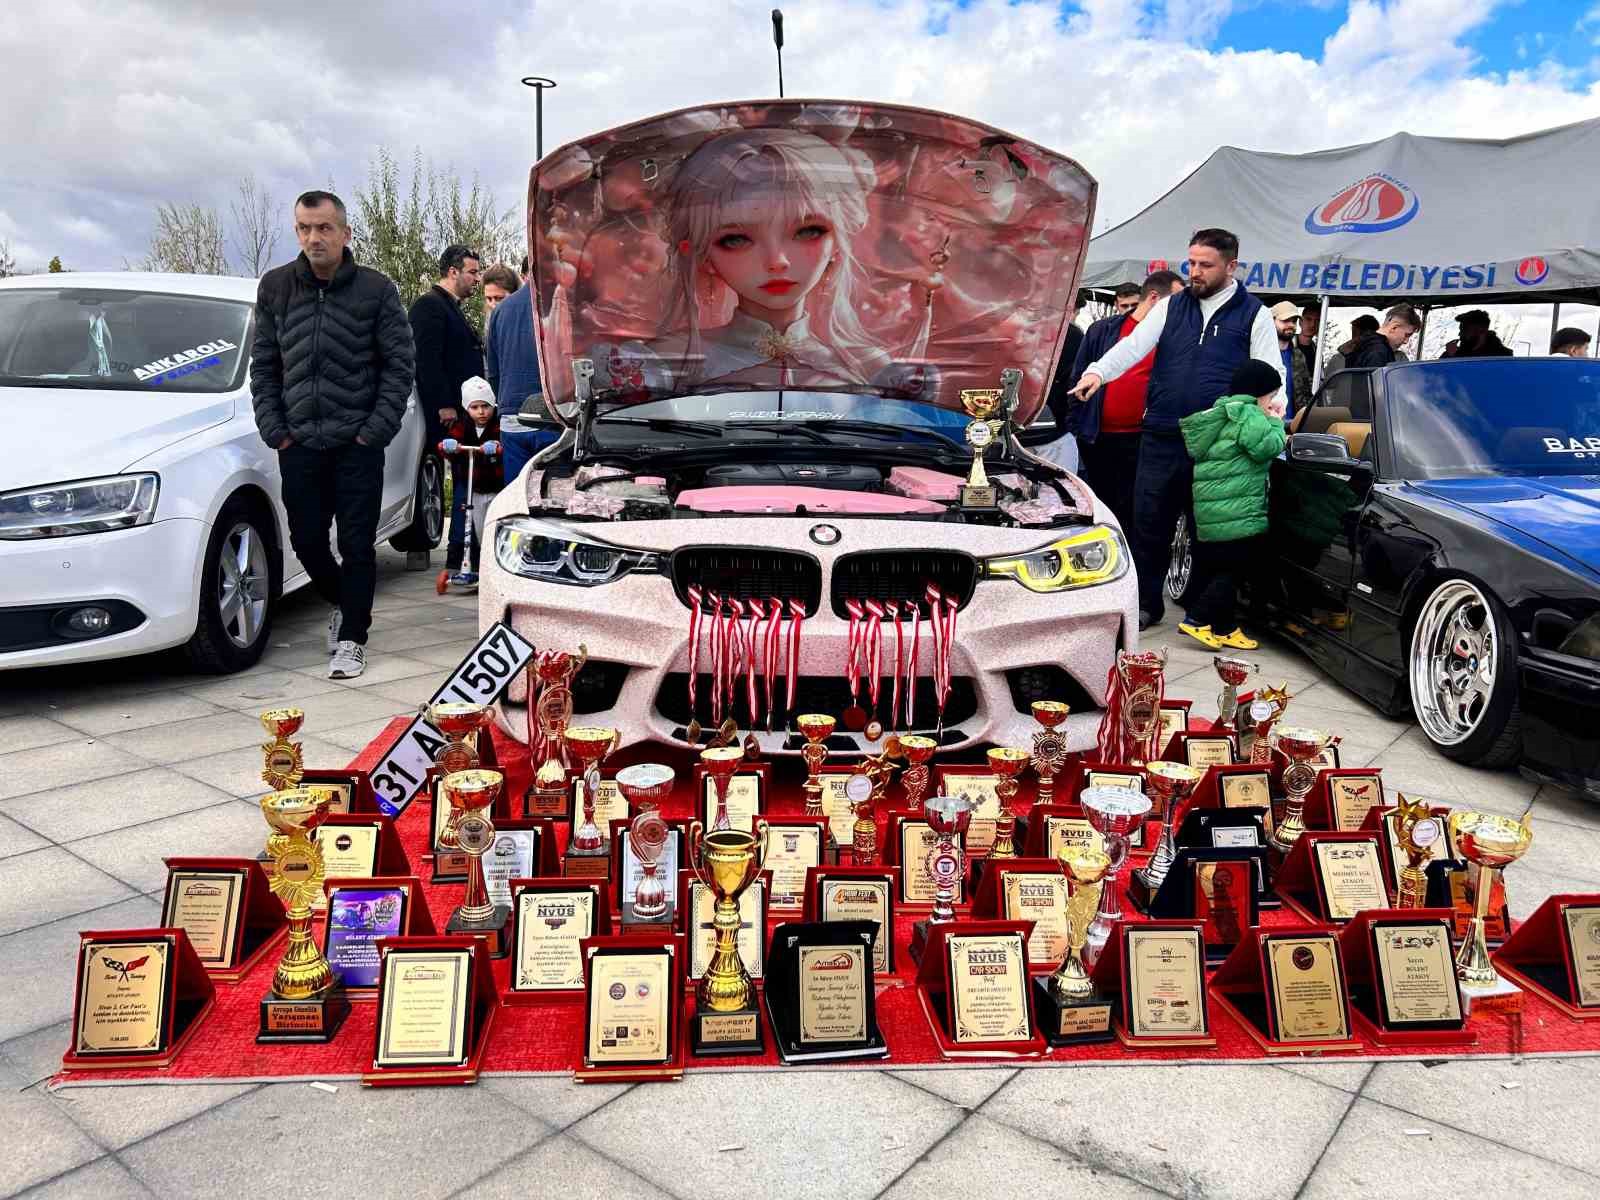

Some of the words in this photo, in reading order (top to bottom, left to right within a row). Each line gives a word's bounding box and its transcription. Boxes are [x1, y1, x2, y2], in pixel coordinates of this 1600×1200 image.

[133, 338, 237, 380] ANKAROLL
[374, 759, 419, 803] 31
[460, 628, 520, 695] 507
